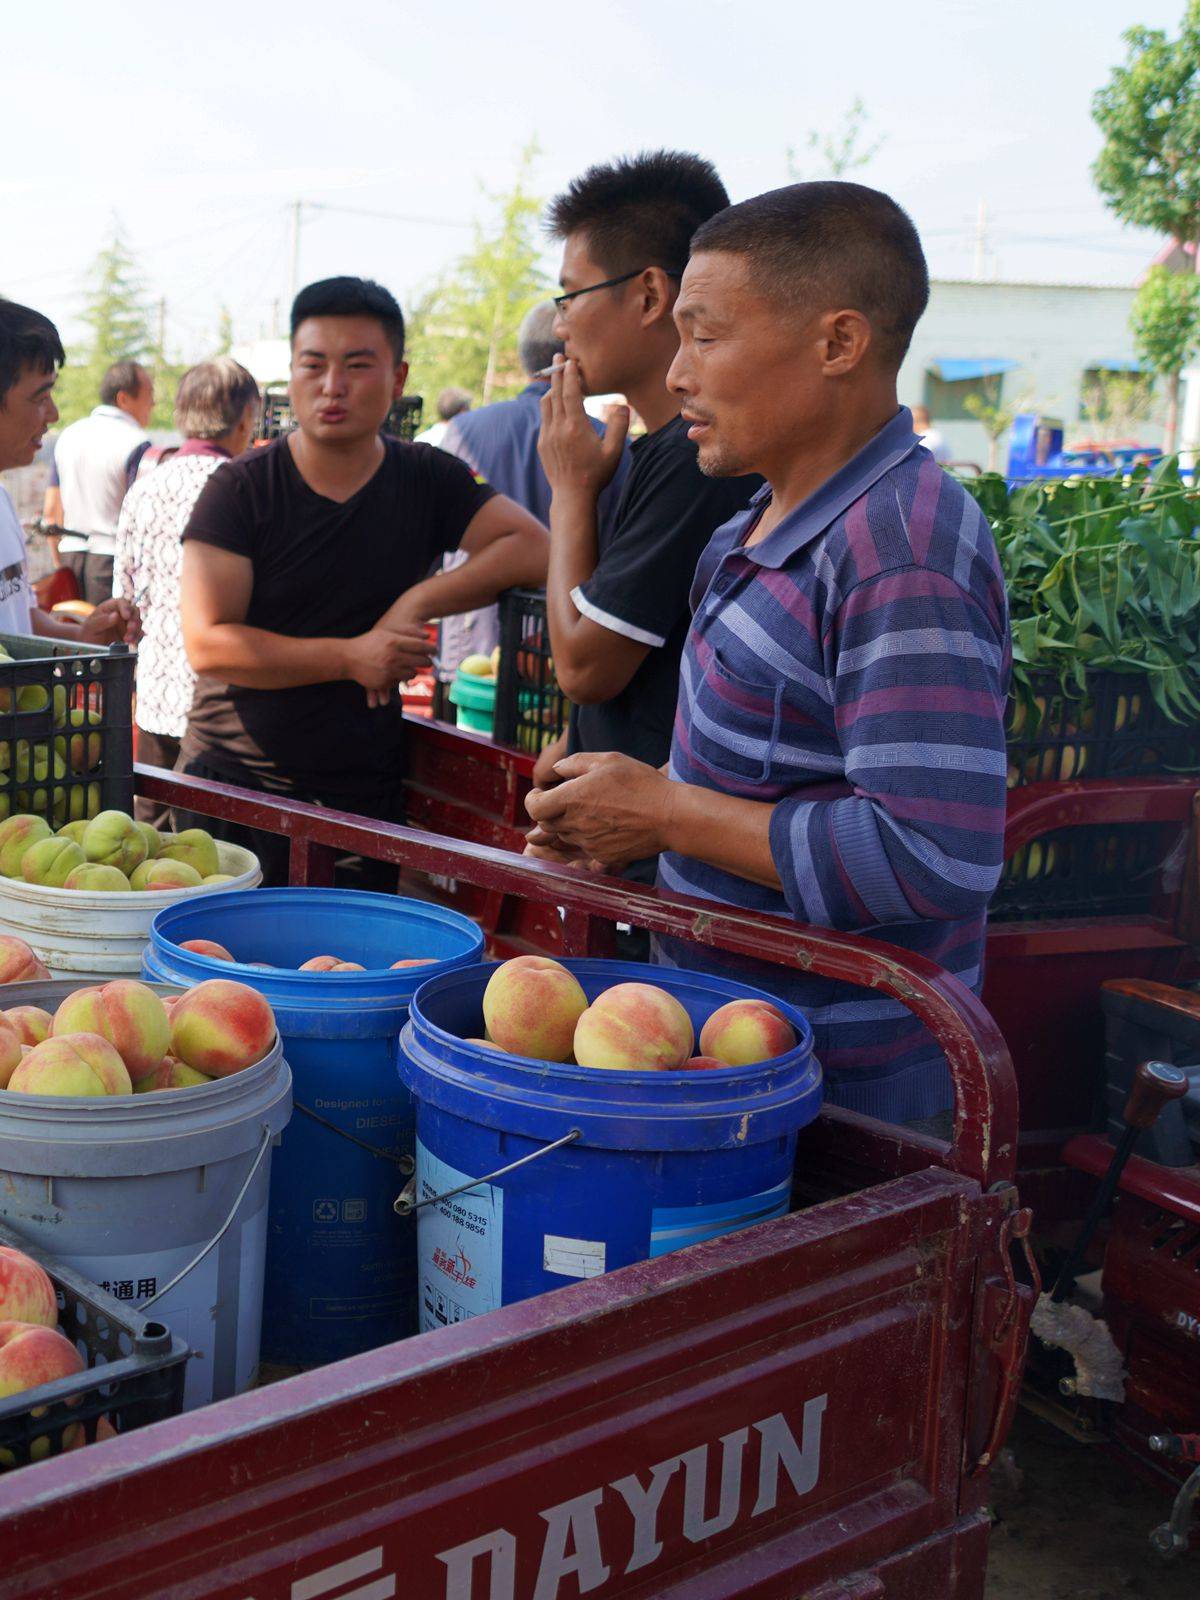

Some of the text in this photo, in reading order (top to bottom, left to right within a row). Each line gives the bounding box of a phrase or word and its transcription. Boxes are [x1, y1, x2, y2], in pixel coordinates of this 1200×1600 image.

[314, 1097, 369, 1110] Designed
[468, 1211, 487, 1226] 5315
[434, 1393, 828, 1600] DAYUN
